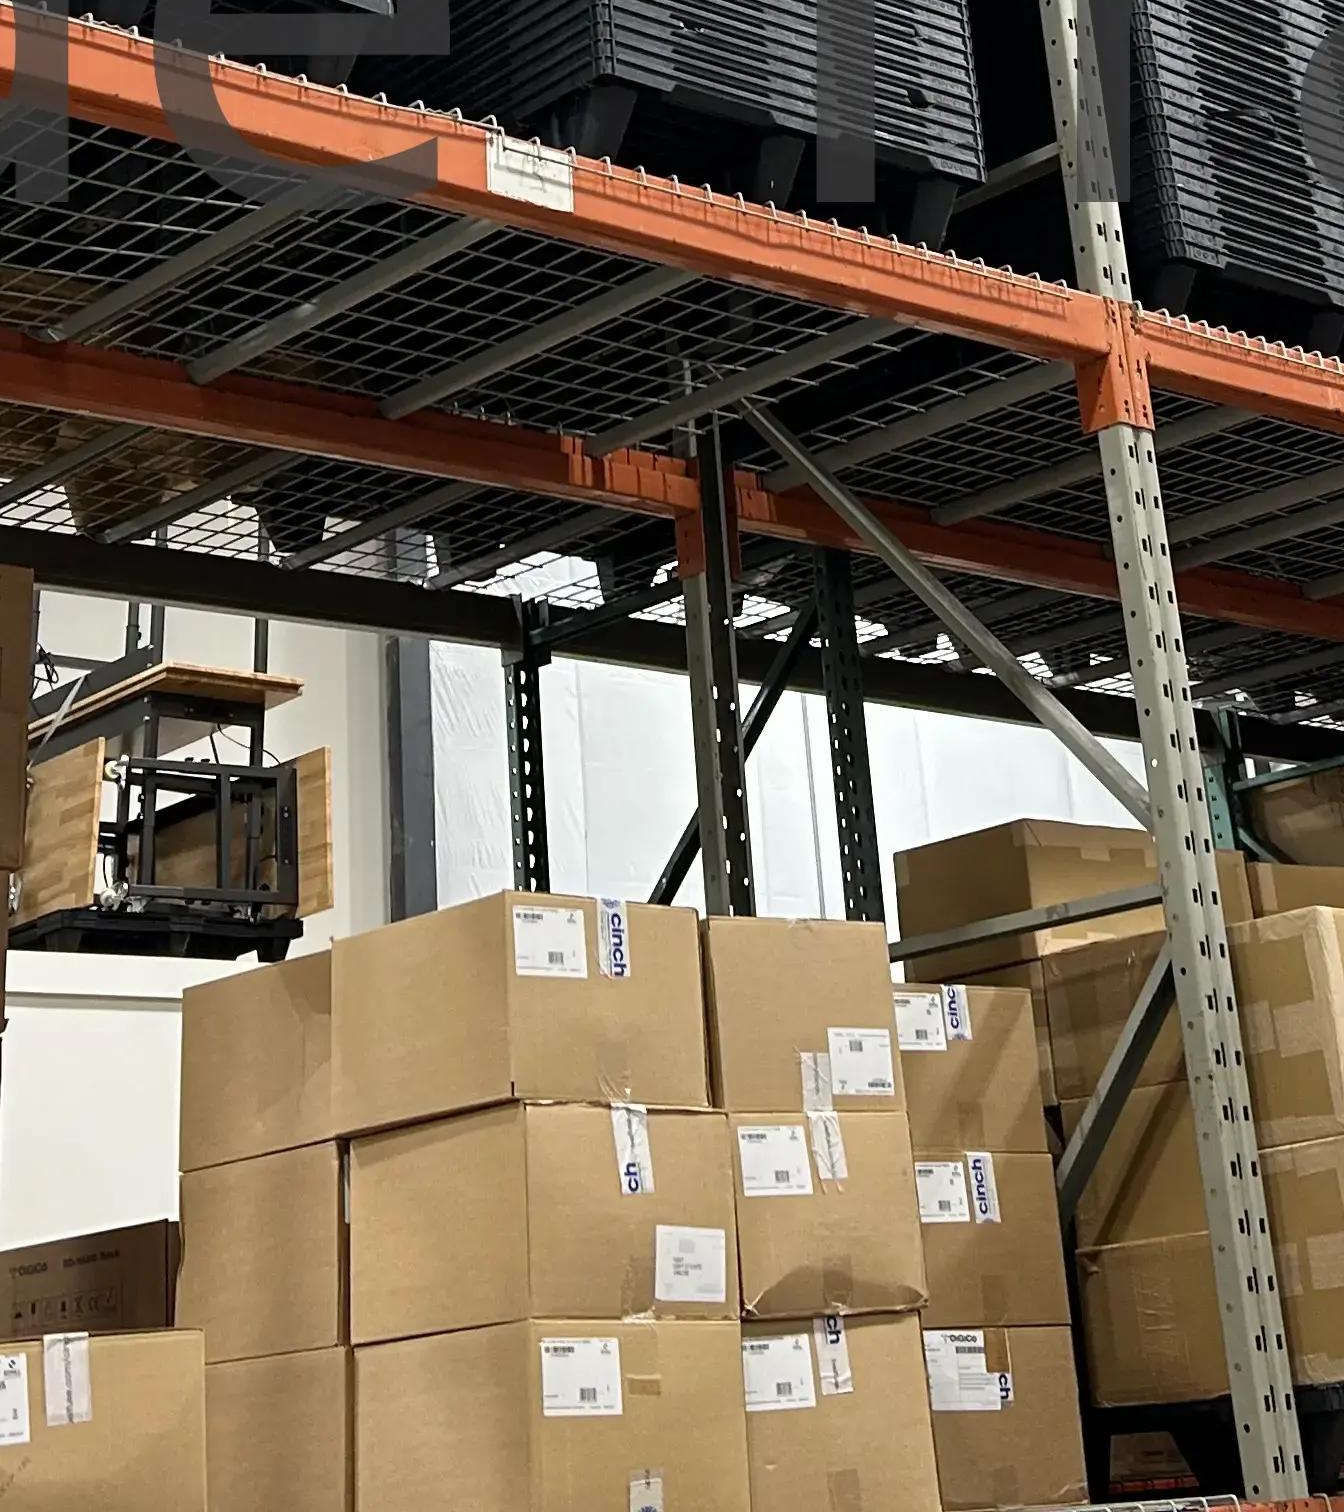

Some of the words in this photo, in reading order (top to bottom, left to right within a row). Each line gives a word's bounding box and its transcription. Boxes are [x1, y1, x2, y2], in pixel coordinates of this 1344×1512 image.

[611, 912, 628, 977] cinch
[947, 984, 960, 1029] cinc
[971, 1158, 987, 1214] cinch
